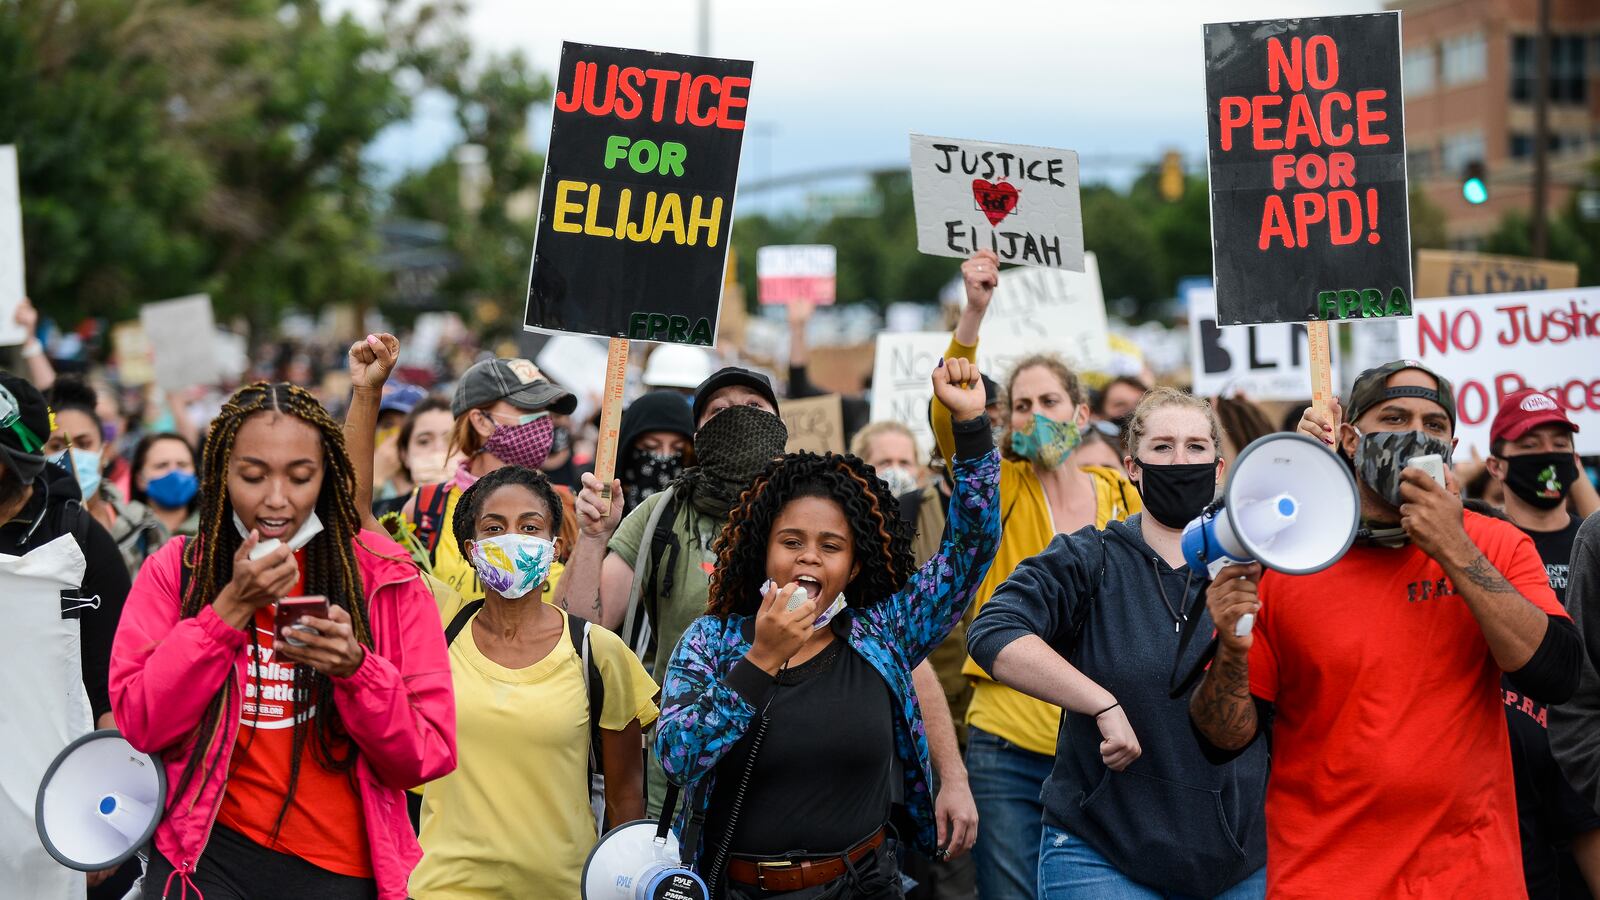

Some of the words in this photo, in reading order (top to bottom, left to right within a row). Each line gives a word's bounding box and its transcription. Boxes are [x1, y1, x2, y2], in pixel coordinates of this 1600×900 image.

[1267, 34, 1339, 92] NO
[556, 61, 750, 129] JUSTICE
[1219, 89, 1390, 151] PEACE
[604, 135, 687, 177] FOR
[932, 144, 1065, 187] JUSTICE
[1272, 152, 1356, 190] FOR
[553, 180, 723, 247] ELIJAH
[1259, 188, 1380, 250] APD!
[945, 220, 1062, 266] ELIJAH
[1318, 287, 1411, 319] FPRA
[628, 311, 714, 346] FPRA
[1418, 309, 1482, 357] NO
[1450, 379, 1489, 425] O
[673, 875, 694, 887] PYLE
